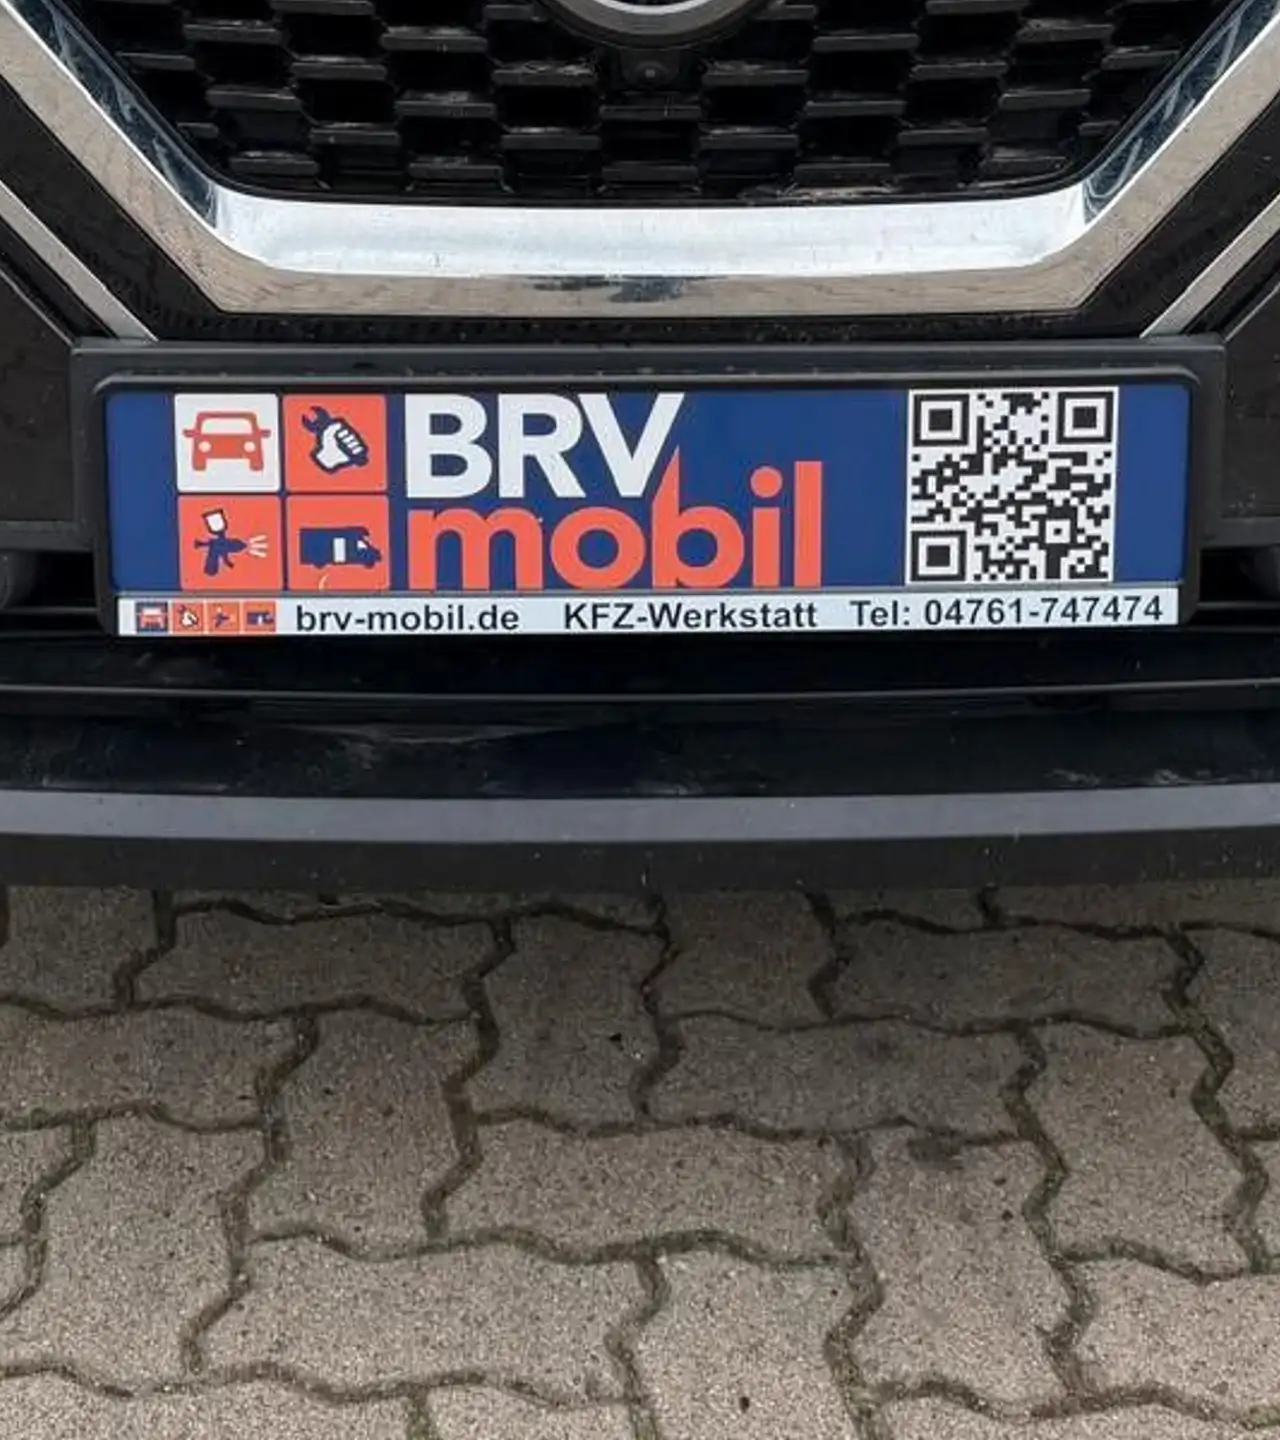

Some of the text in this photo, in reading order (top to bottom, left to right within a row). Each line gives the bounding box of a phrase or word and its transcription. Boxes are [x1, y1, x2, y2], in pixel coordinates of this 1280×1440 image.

[404, 392, 685, 499] BRV
[406, 444, 824, 591] mobil
[296, 595, 1164, 632] brv-mobil.de KFZ-Werkstatt Tel: 04761-747474
